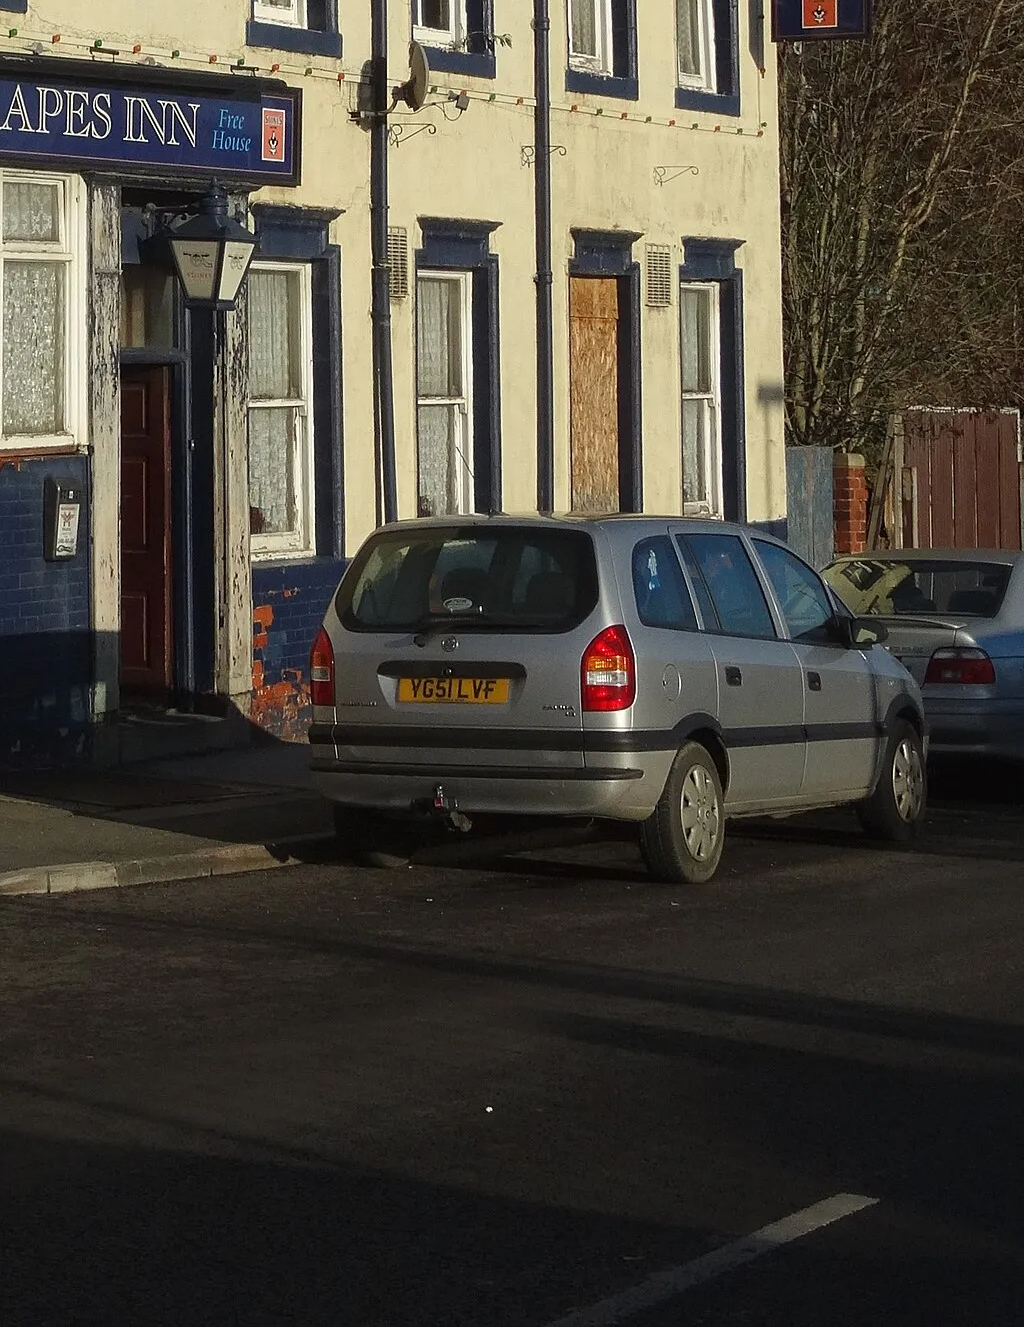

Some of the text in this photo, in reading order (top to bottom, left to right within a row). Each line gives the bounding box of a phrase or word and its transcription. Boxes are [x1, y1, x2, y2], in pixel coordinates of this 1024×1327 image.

[122, 96, 201, 148] INN
[218, 108, 245, 130] Free
[211, 129, 251, 152] House
